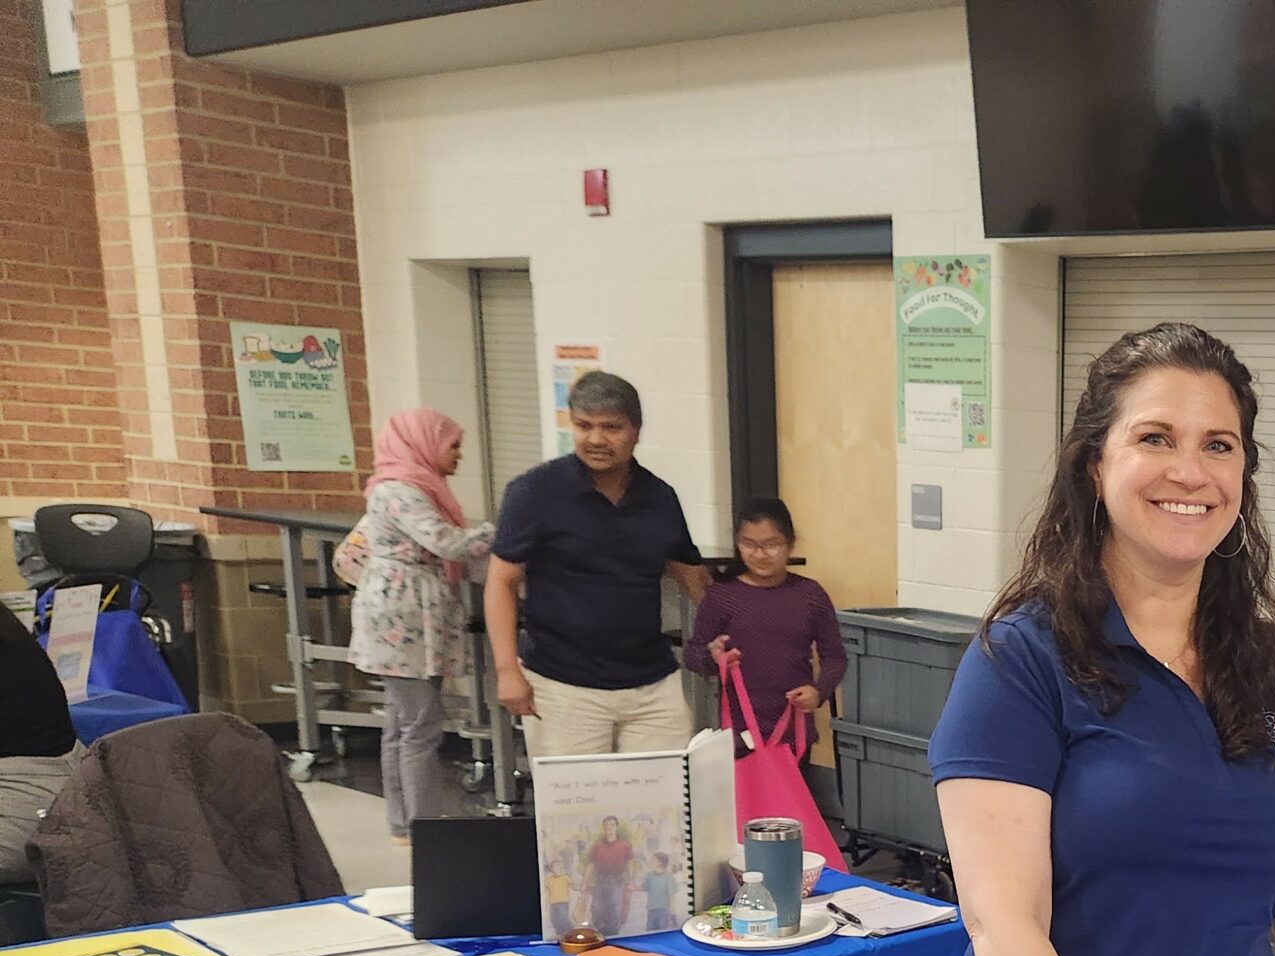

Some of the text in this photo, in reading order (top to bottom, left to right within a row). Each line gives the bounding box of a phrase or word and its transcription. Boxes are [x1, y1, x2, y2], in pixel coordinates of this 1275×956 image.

[904, 293, 979, 318] Food for Thought
